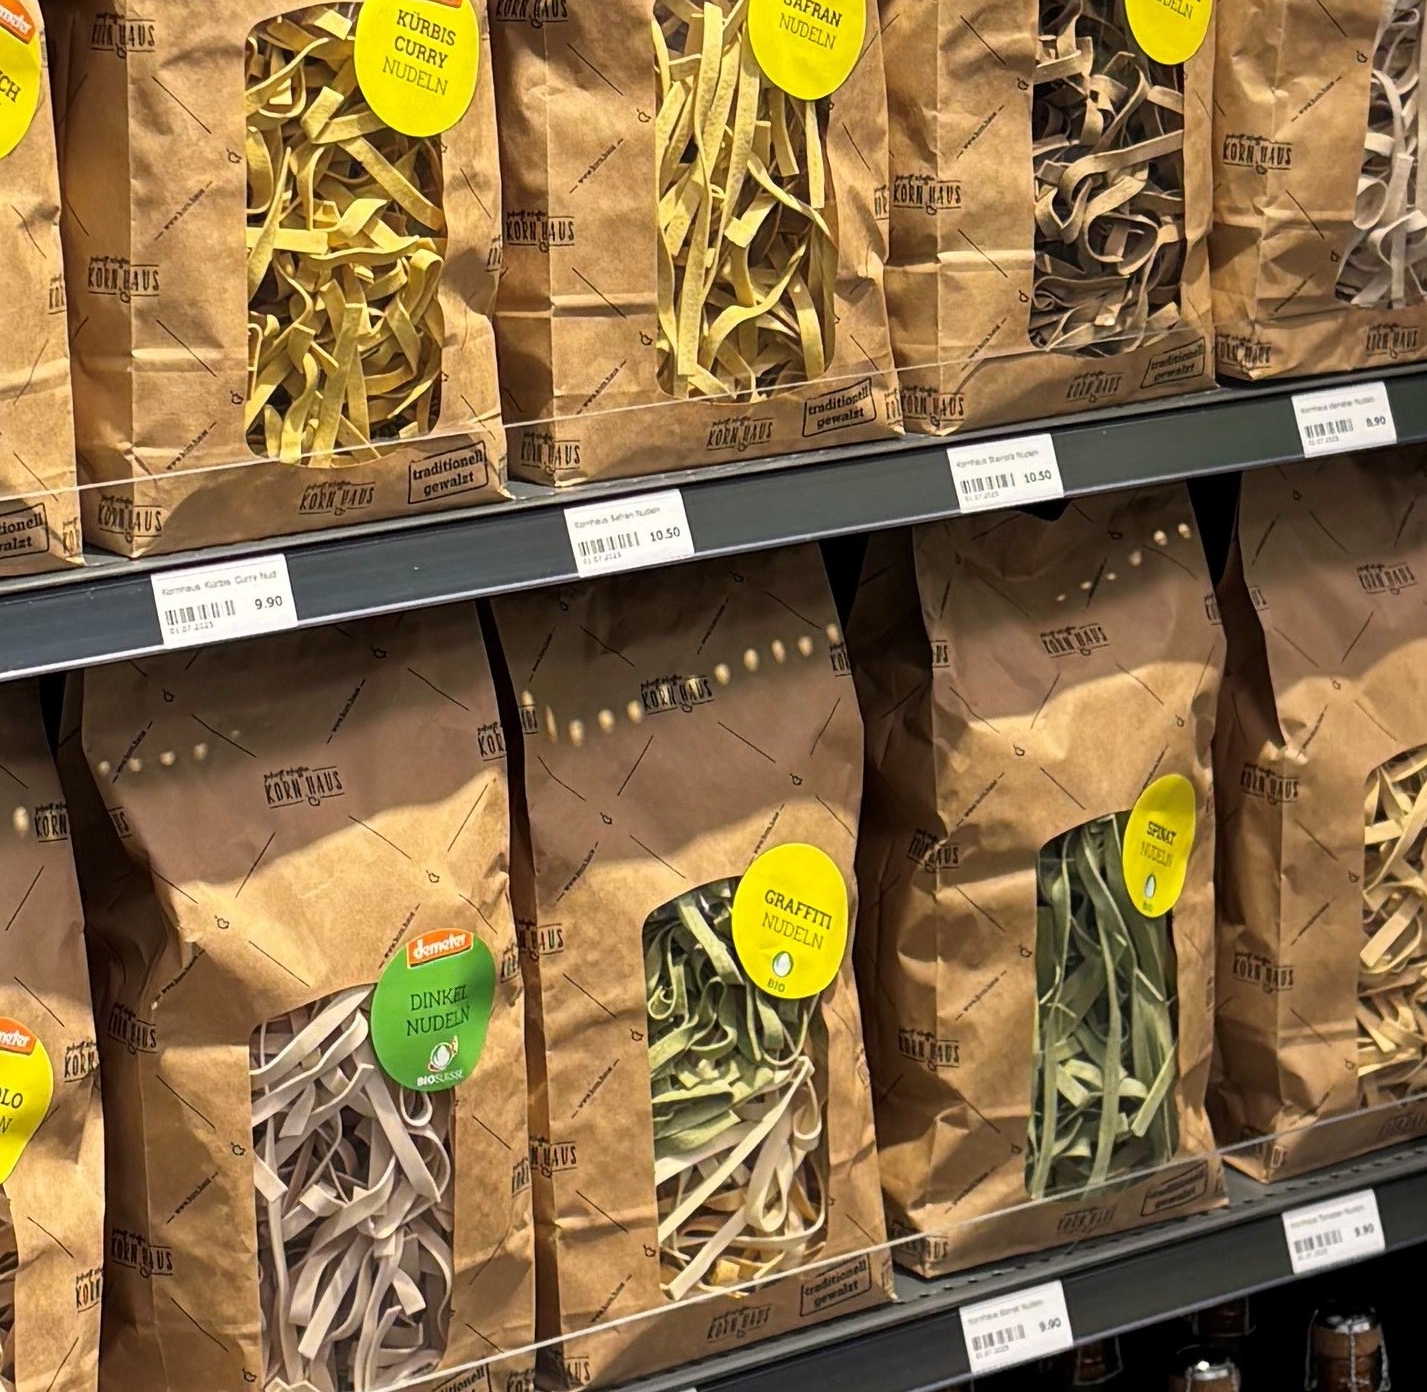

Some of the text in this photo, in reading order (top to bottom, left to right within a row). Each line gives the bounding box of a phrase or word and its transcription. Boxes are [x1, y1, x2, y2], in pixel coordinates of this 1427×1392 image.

[396, 8, 457, 47] KÜRBIS
[779, 13, 837, 51] NUDELN
[393, 35, 450, 70] CURRY
[382, 56, 449, 97] NUDELN
[1223, 139, 1292, 165] KORN HAUS
[893, 183, 962, 204] KORN HAUS
[506, 218, 575, 242] KORN HAUS
[88, 265, 160, 292] KORN HAUS
[816, 407, 864, 430] gewalzt
[412, 450, 484, 482] traditionell
[1024, 470, 1052, 484] 10.50
[299, 482, 375, 512] KORN HAUS
[423, 470, 474, 497] gewalzt
[650, 527, 680, 542] 10.50
[254, 595, 283, 610] 9.90
[641, 678, 713, 711] KORN HAUS
[264, 770, 344, 805] KORN HAUS
[764, 888, 832, 930] GRAFFITI
[761, 910, 824, 950] NUDELN
[411, 932, 468, 960] demeter
[409, 984, 469, 1011] DINKEL
[767, 977, 786, 993] BIO
[405, 1006, 471, 1037] NUDELN
[804, 1259, 867, 1299] traditionell
[813, 1279, 859, 1308] gewalzt
